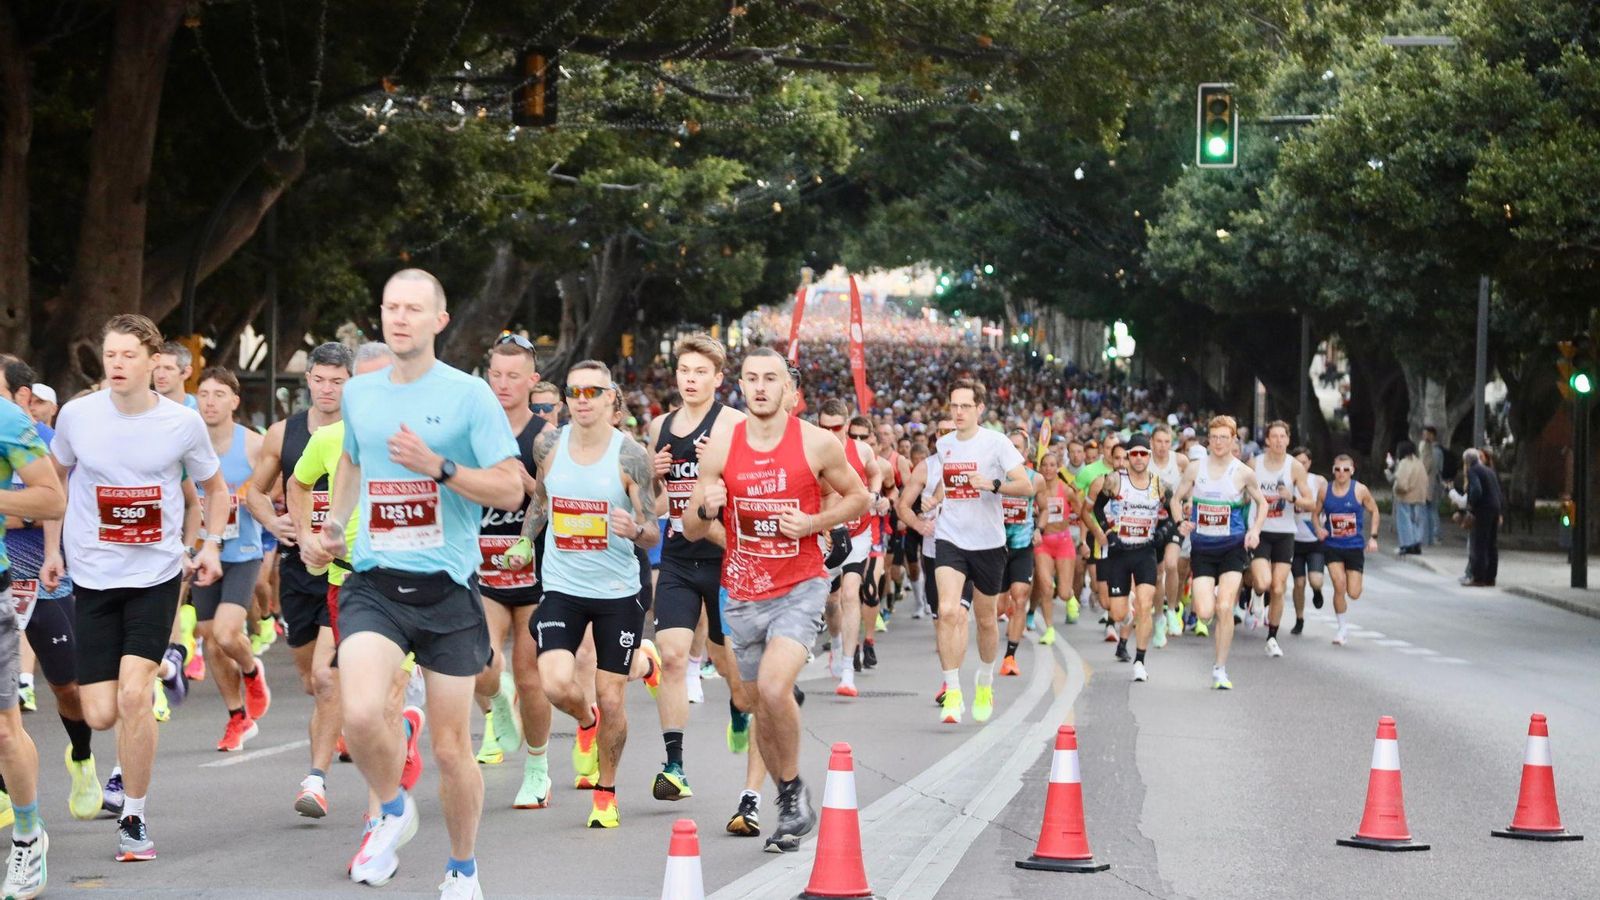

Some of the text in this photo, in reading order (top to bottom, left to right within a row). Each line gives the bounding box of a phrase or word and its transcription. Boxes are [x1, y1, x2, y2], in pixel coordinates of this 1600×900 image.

[949, 474, 968, 484] 4700
[112, 488, 158, 498] GENERALI
[564, 500, 605, 511] GENERALI
[750, 502, 793, 512] GENERALI
[112, 507, 146, 518] 5360
[379, 503, 424, 520] 12514
[753, 519, 778, 532] 265
